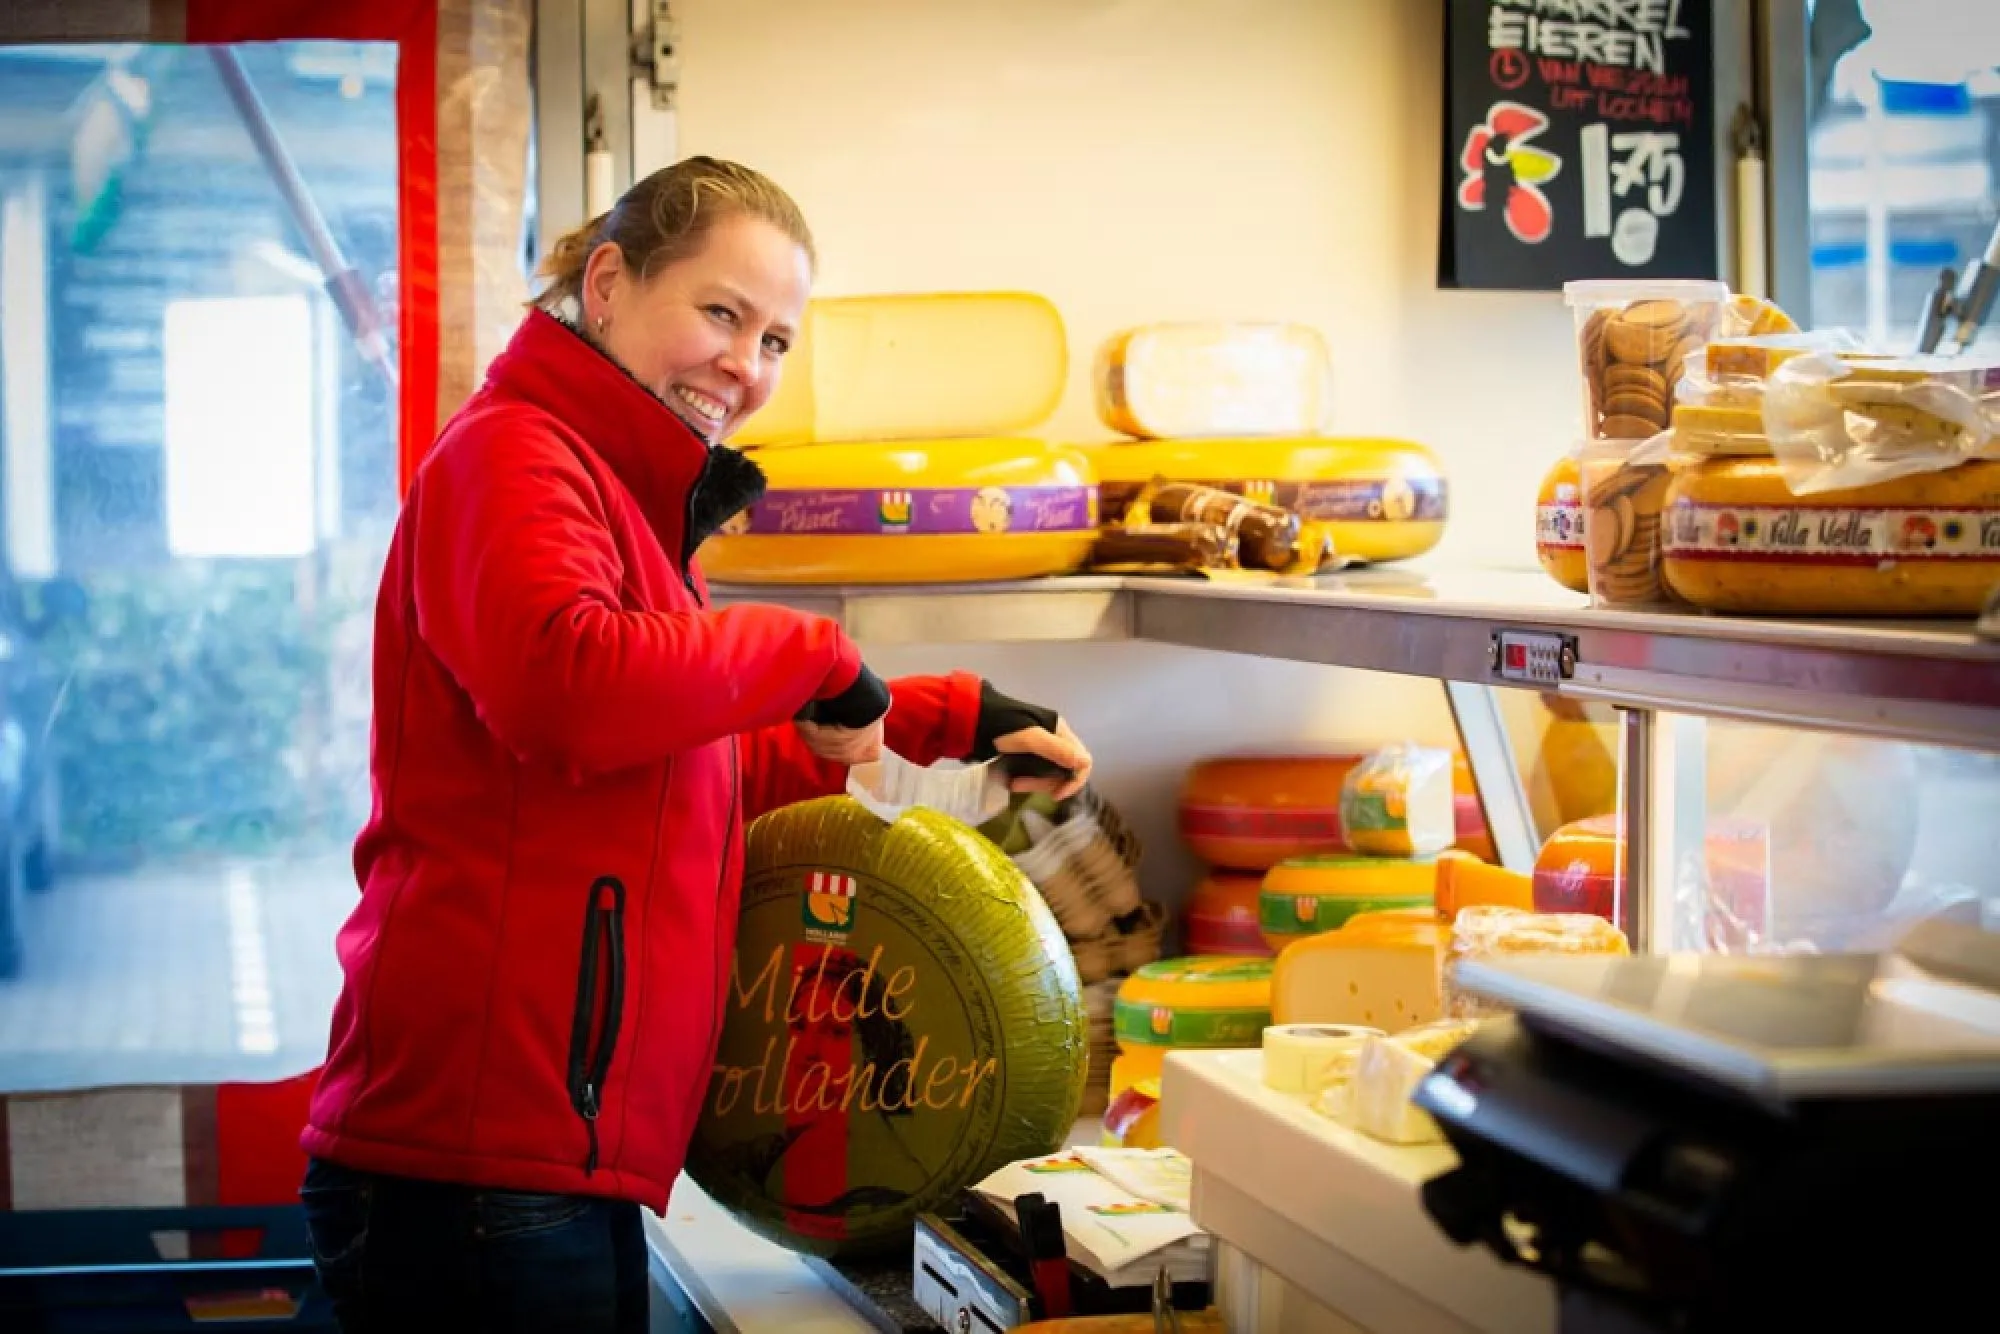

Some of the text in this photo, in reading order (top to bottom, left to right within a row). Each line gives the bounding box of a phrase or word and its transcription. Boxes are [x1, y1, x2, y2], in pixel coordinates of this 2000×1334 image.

[1487, 6, 1665, 76] EIEREN
[731, 942, 916, 1023] Milde
[712, 1035, 998, 1118] ollander
